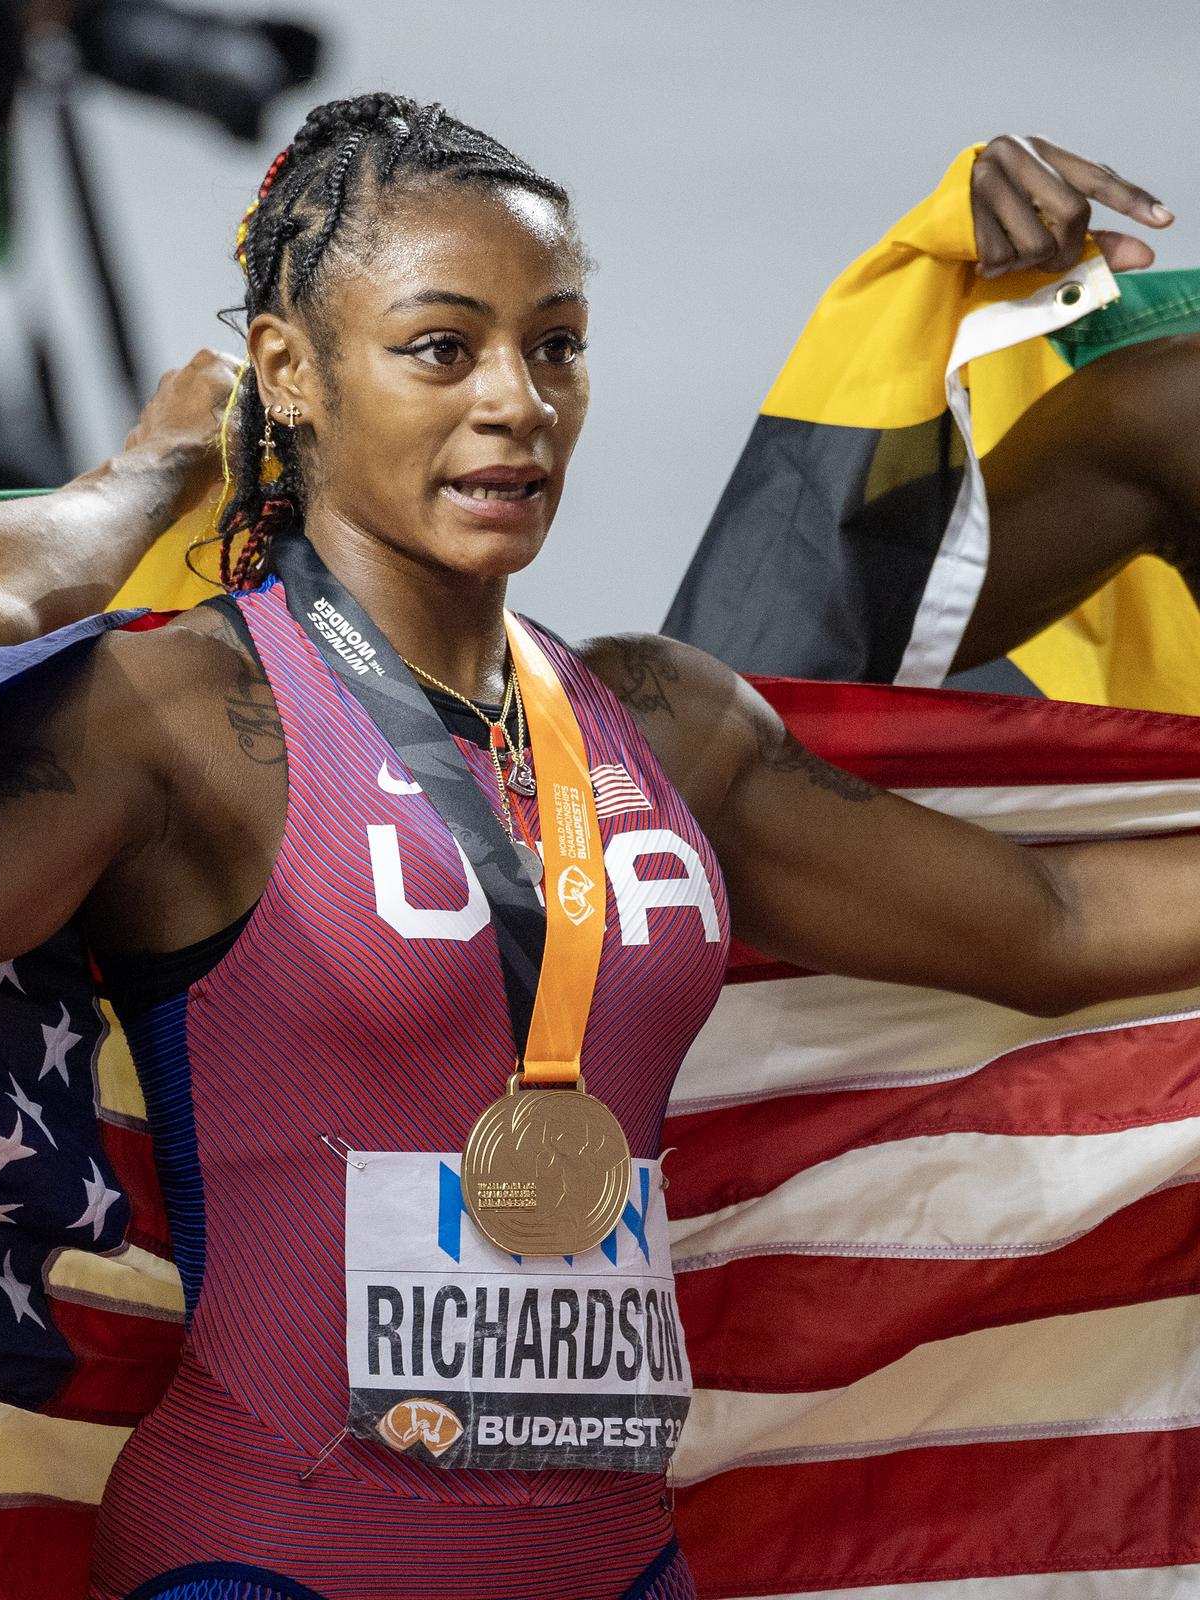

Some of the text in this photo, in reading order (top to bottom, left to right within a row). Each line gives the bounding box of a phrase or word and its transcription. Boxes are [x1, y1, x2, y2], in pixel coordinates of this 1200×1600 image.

[306, 612, 370, 676] WITNESS
[313, 596, 386, 677] THE WONDER
[553, 783, 567, 857] WORLD ATHLETICS
[561, 785, 577, 859] CHAMPIONSHIPS
[570, 787, 587, 859] BUDAPEST 23
[366, 824, 721, 946] UA
[366, 1284, 684, 1382] RICHARDSON
[477, 1415, 662, 1448] BUDAPEST
